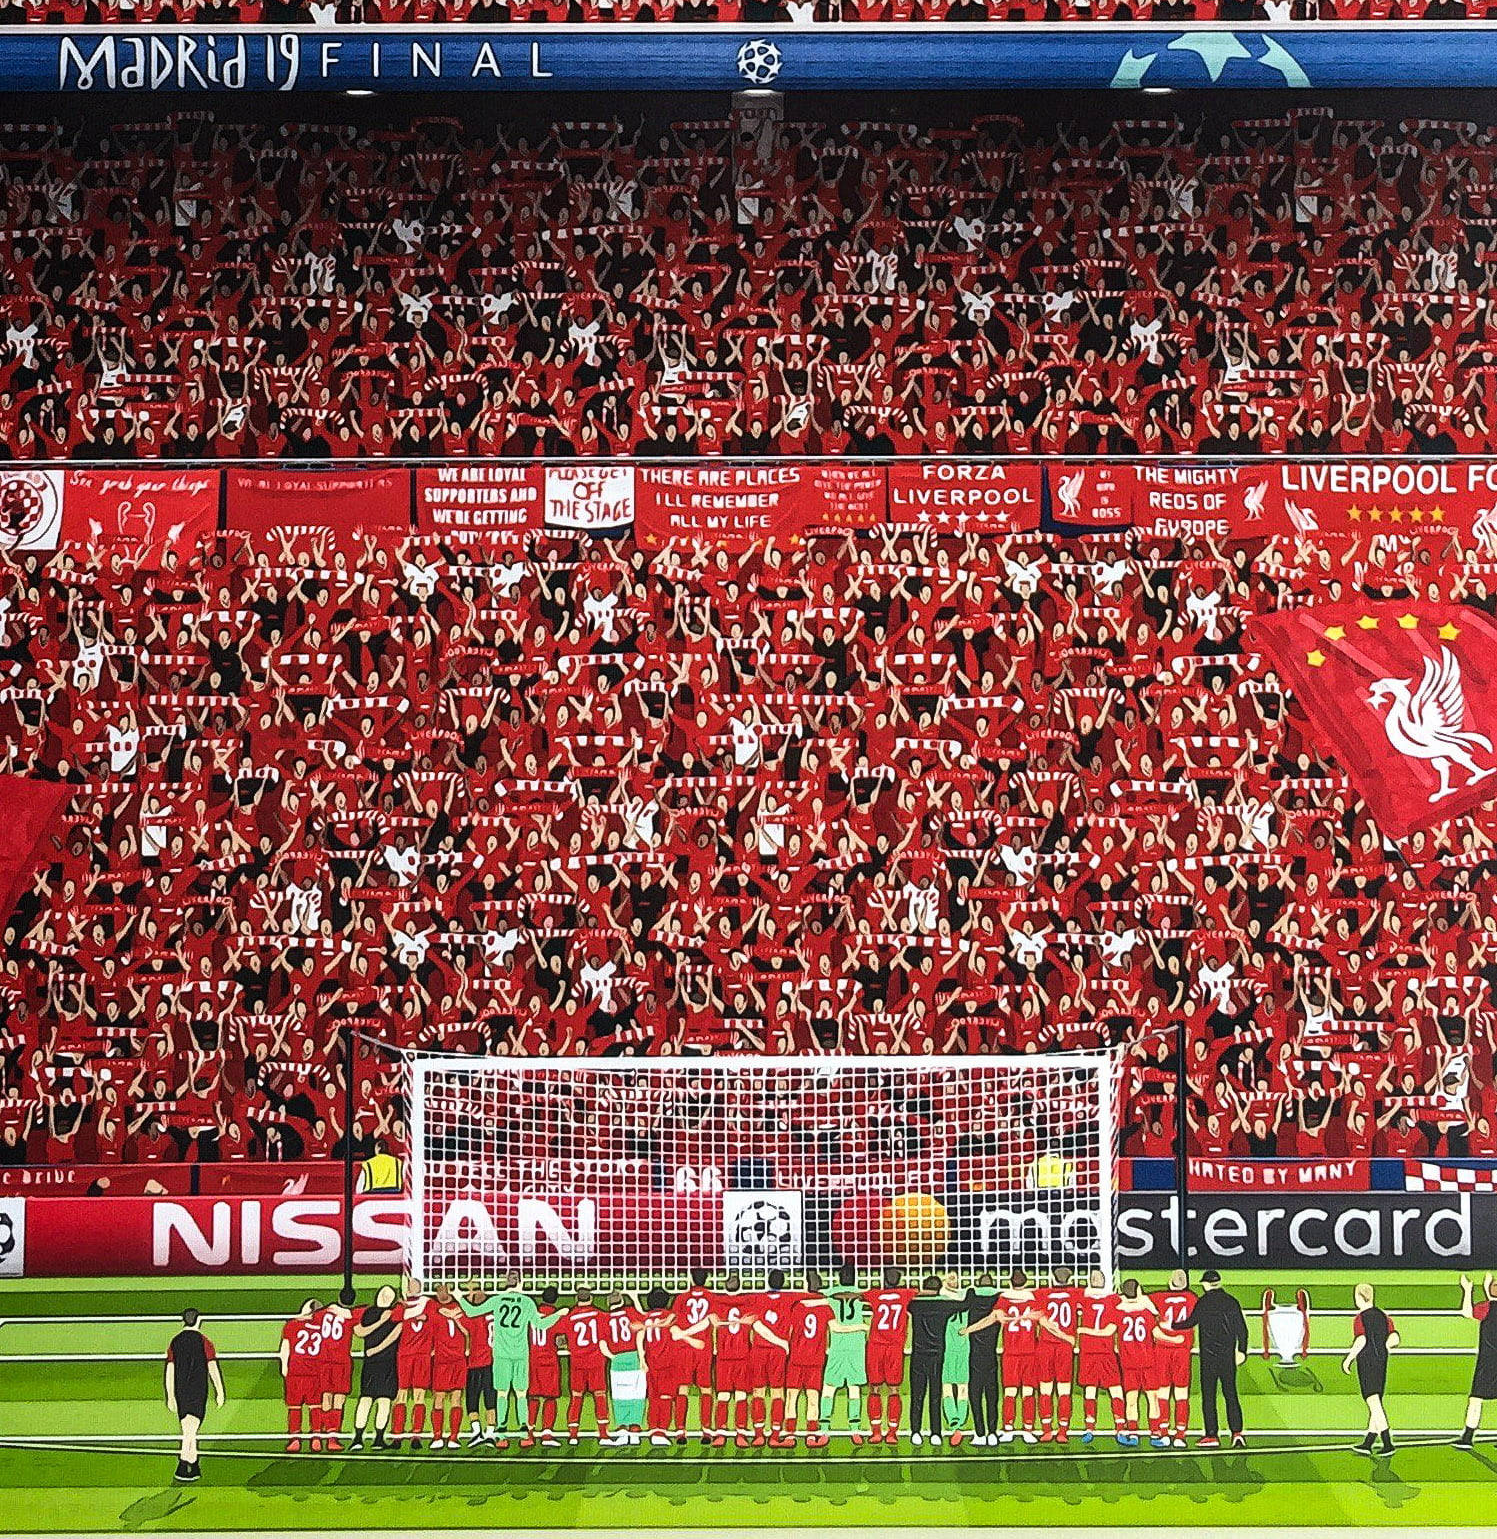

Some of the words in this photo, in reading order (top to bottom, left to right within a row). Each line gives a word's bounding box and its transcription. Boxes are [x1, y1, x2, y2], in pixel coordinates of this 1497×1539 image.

[266, 34, 299, 91] 19
[437, 468, 458, 482] WE
[489, 468, 526, 482] LOYAL
[641, 468, 694, 486] THERE
[699, 469, 732, 486] ARE
[736, 467, 800, 486] PLACES
[923, 464, 1006, 480] FORZA
[1134, 466, 1168, 483] THE
[1174, 467, 1240, 485] MIGHTY
[1281, 465, 1458, 494] LIVERPOOL
[424, 487, 508, 504] SUPPORTERS
[511, 487, 537, 503] AND
[692, 492, 779, 508] REMEMBER
[893, 487, 1035, 505] LIVERPOOL
[1150, 492, 1198, 509] REDS
[1204, 493, 1227, 509] OF
[473, 507, 528, 525] GETTING
[549, 499, 581, 520] THE
[586, 499, 632, 522] STAGE
[671, 514, 699, 528] ALL
[707, 514, 728, 528] MY
[734, 514, 771, 528] LIFE
[22, 1169, 76, 1185] drive
[1189, 1159, 1254, 1184] HATED
[1263, 1167, 1290, 1185] BY
[1299, 1160, 1356, 1183] MANY
[152, 1198, 597, 1267] NISSAN
[979, 1192, 1471, 1258] mastercard
[321, 1313, 344, 1340] 66
[499, 1305, 521, 1329] 22
[804, 1313, 817, 1339] 9
[877, 1304, 901, 1330] 27
[1048, 1302, 1072, 1328] 20
[1092, 1304, 1105, 1331] 7
[573, 1319, 598, 1347] 21
[609, 1316, 632, 1343] 18
[1122, 1317, 1146, 1342] 26
[295, 1330, 322, 1356] 23
